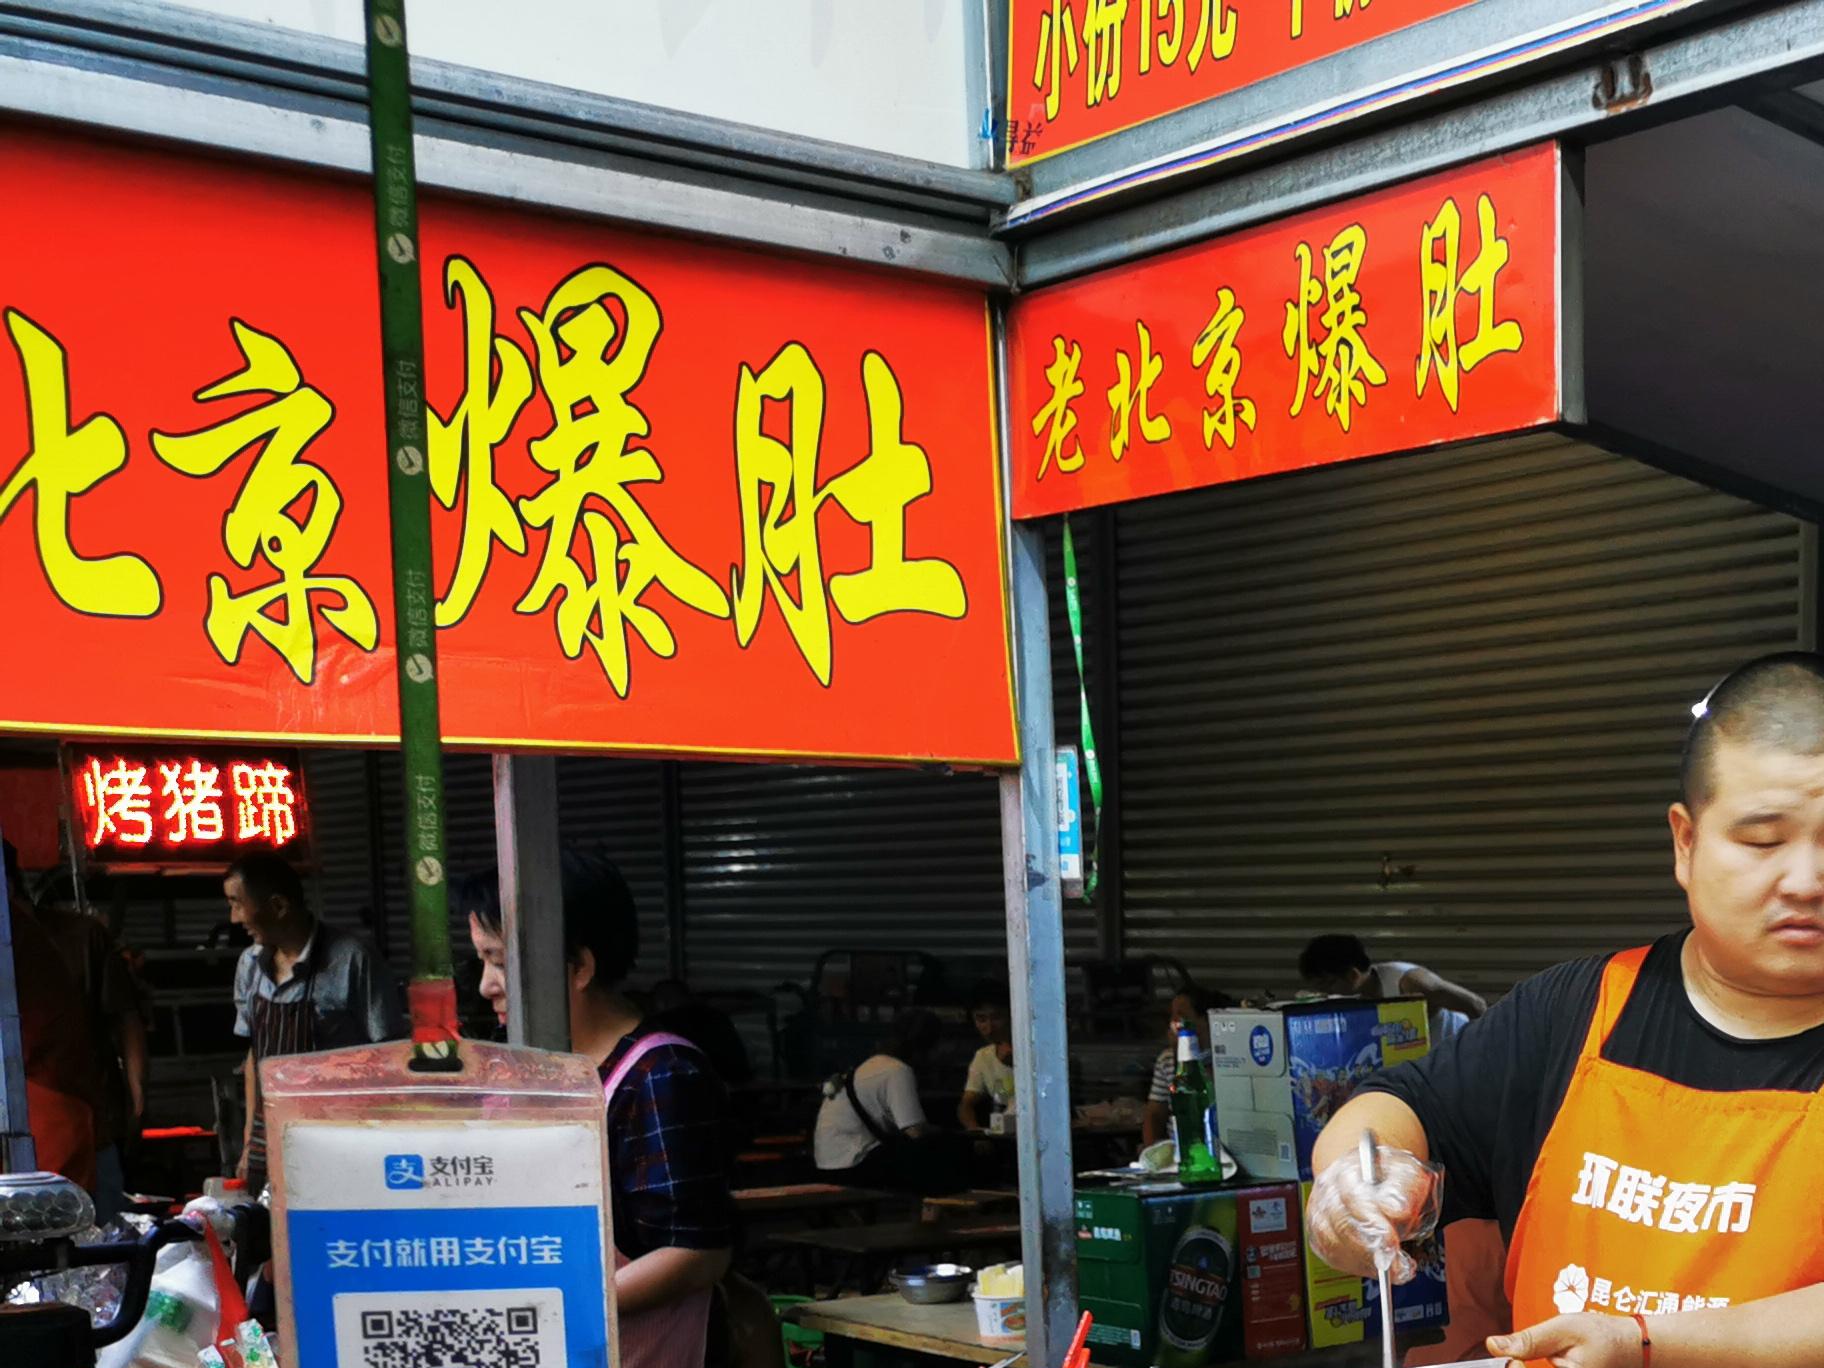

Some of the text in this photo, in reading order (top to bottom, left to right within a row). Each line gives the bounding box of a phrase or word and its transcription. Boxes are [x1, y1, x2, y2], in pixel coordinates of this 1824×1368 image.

[1031, 192, 1525, 481] 老北京爆肚
[396, 360, 418, 440] 微信支付
[405, 570, 427, 648] 微信支付
[83, 757, 296, 845] 烤猪蹄
[429, 1155, 494, 1176] 支付宝
[433, 1177, 494, 1188] ALIPAY
[1571, 1152, 1757, 1233] 环联夜市
[326, 1235, 563, 1269] 支付就用支付宝
